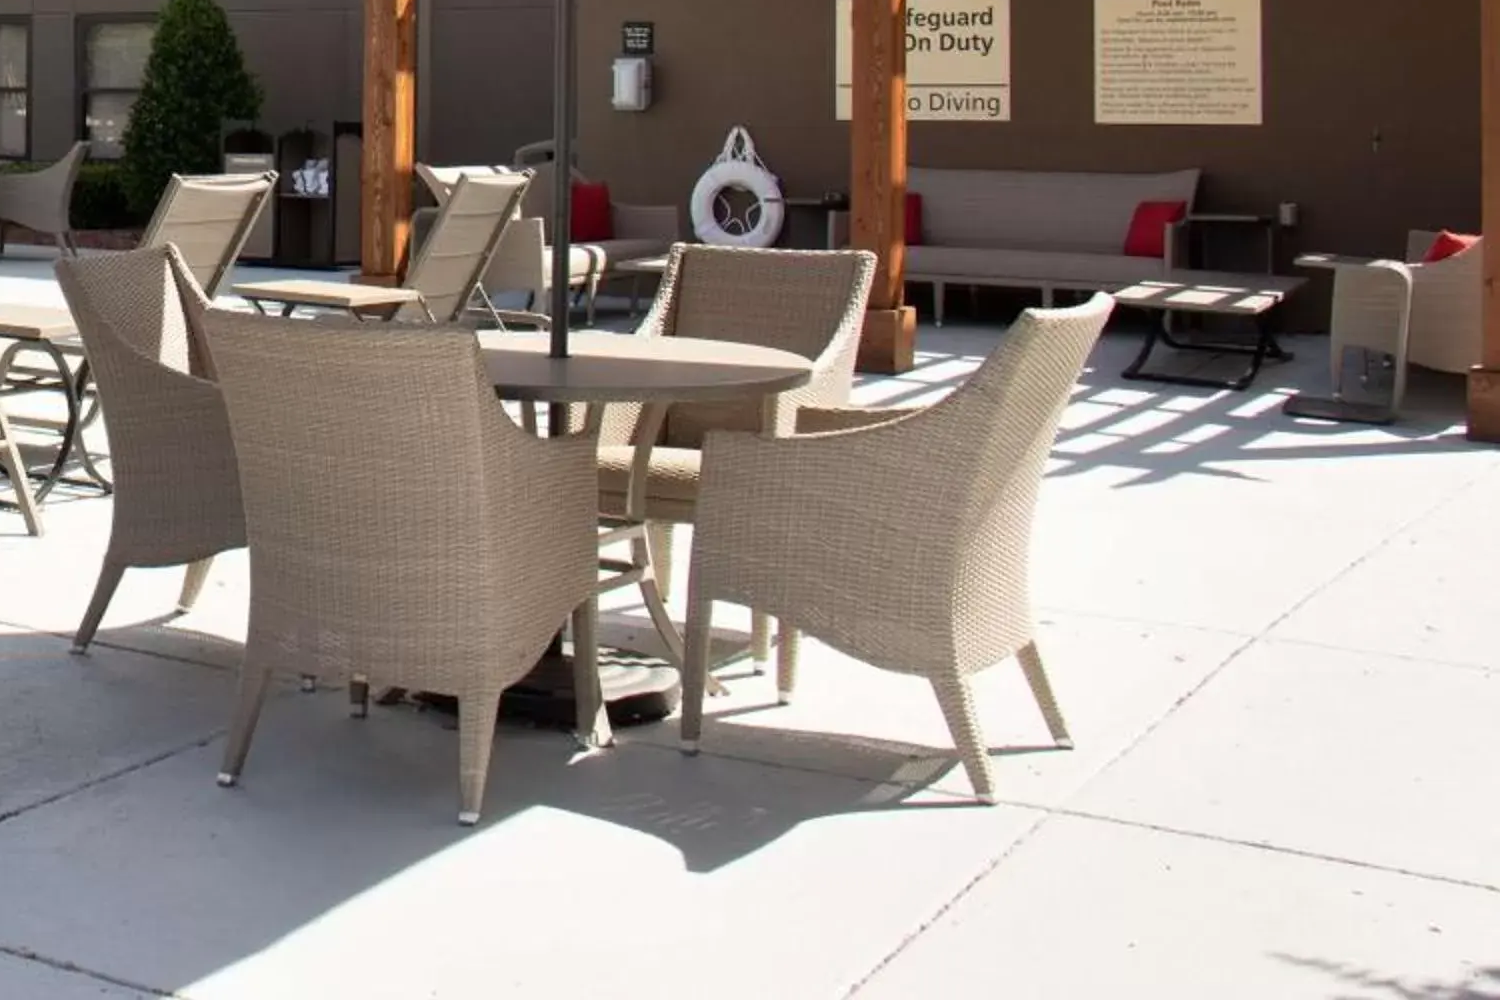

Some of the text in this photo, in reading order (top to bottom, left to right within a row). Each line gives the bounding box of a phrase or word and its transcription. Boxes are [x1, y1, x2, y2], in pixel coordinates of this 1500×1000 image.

[906, 7, 994, 32] feguard
[905, 33, 994, 57] On Duty
[907, 92, 1000, 117] o Diving
